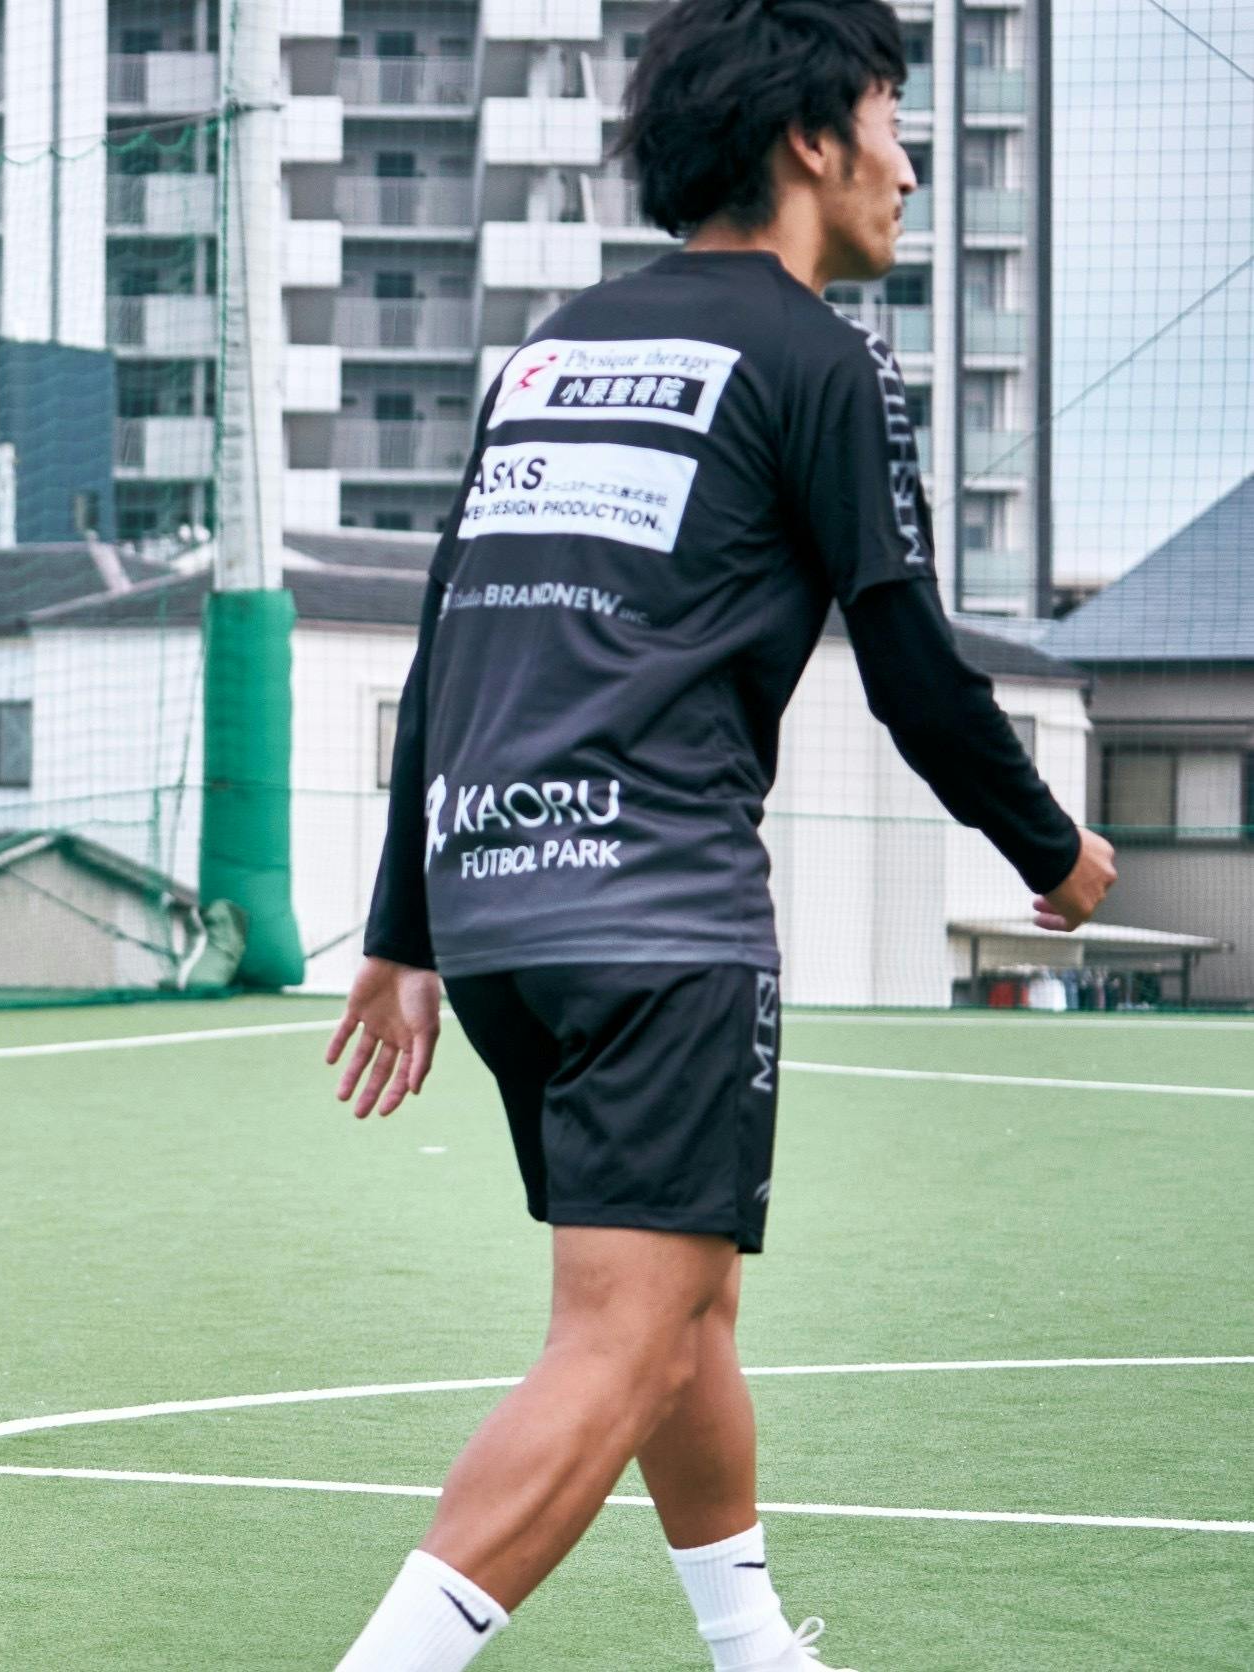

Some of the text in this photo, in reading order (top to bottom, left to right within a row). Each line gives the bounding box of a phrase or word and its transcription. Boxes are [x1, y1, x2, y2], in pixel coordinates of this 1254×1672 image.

[643, 346, 712, 376] therapy
[559, 375, 687, 409] 小原整骨院
[472, 457, 547, 495] ASKS
[483, 582, 623, 616] BRANDNEW
[453, 779, 621, 835] KAORU
[460, 838, 622, 880] FÚTBOL PARK
